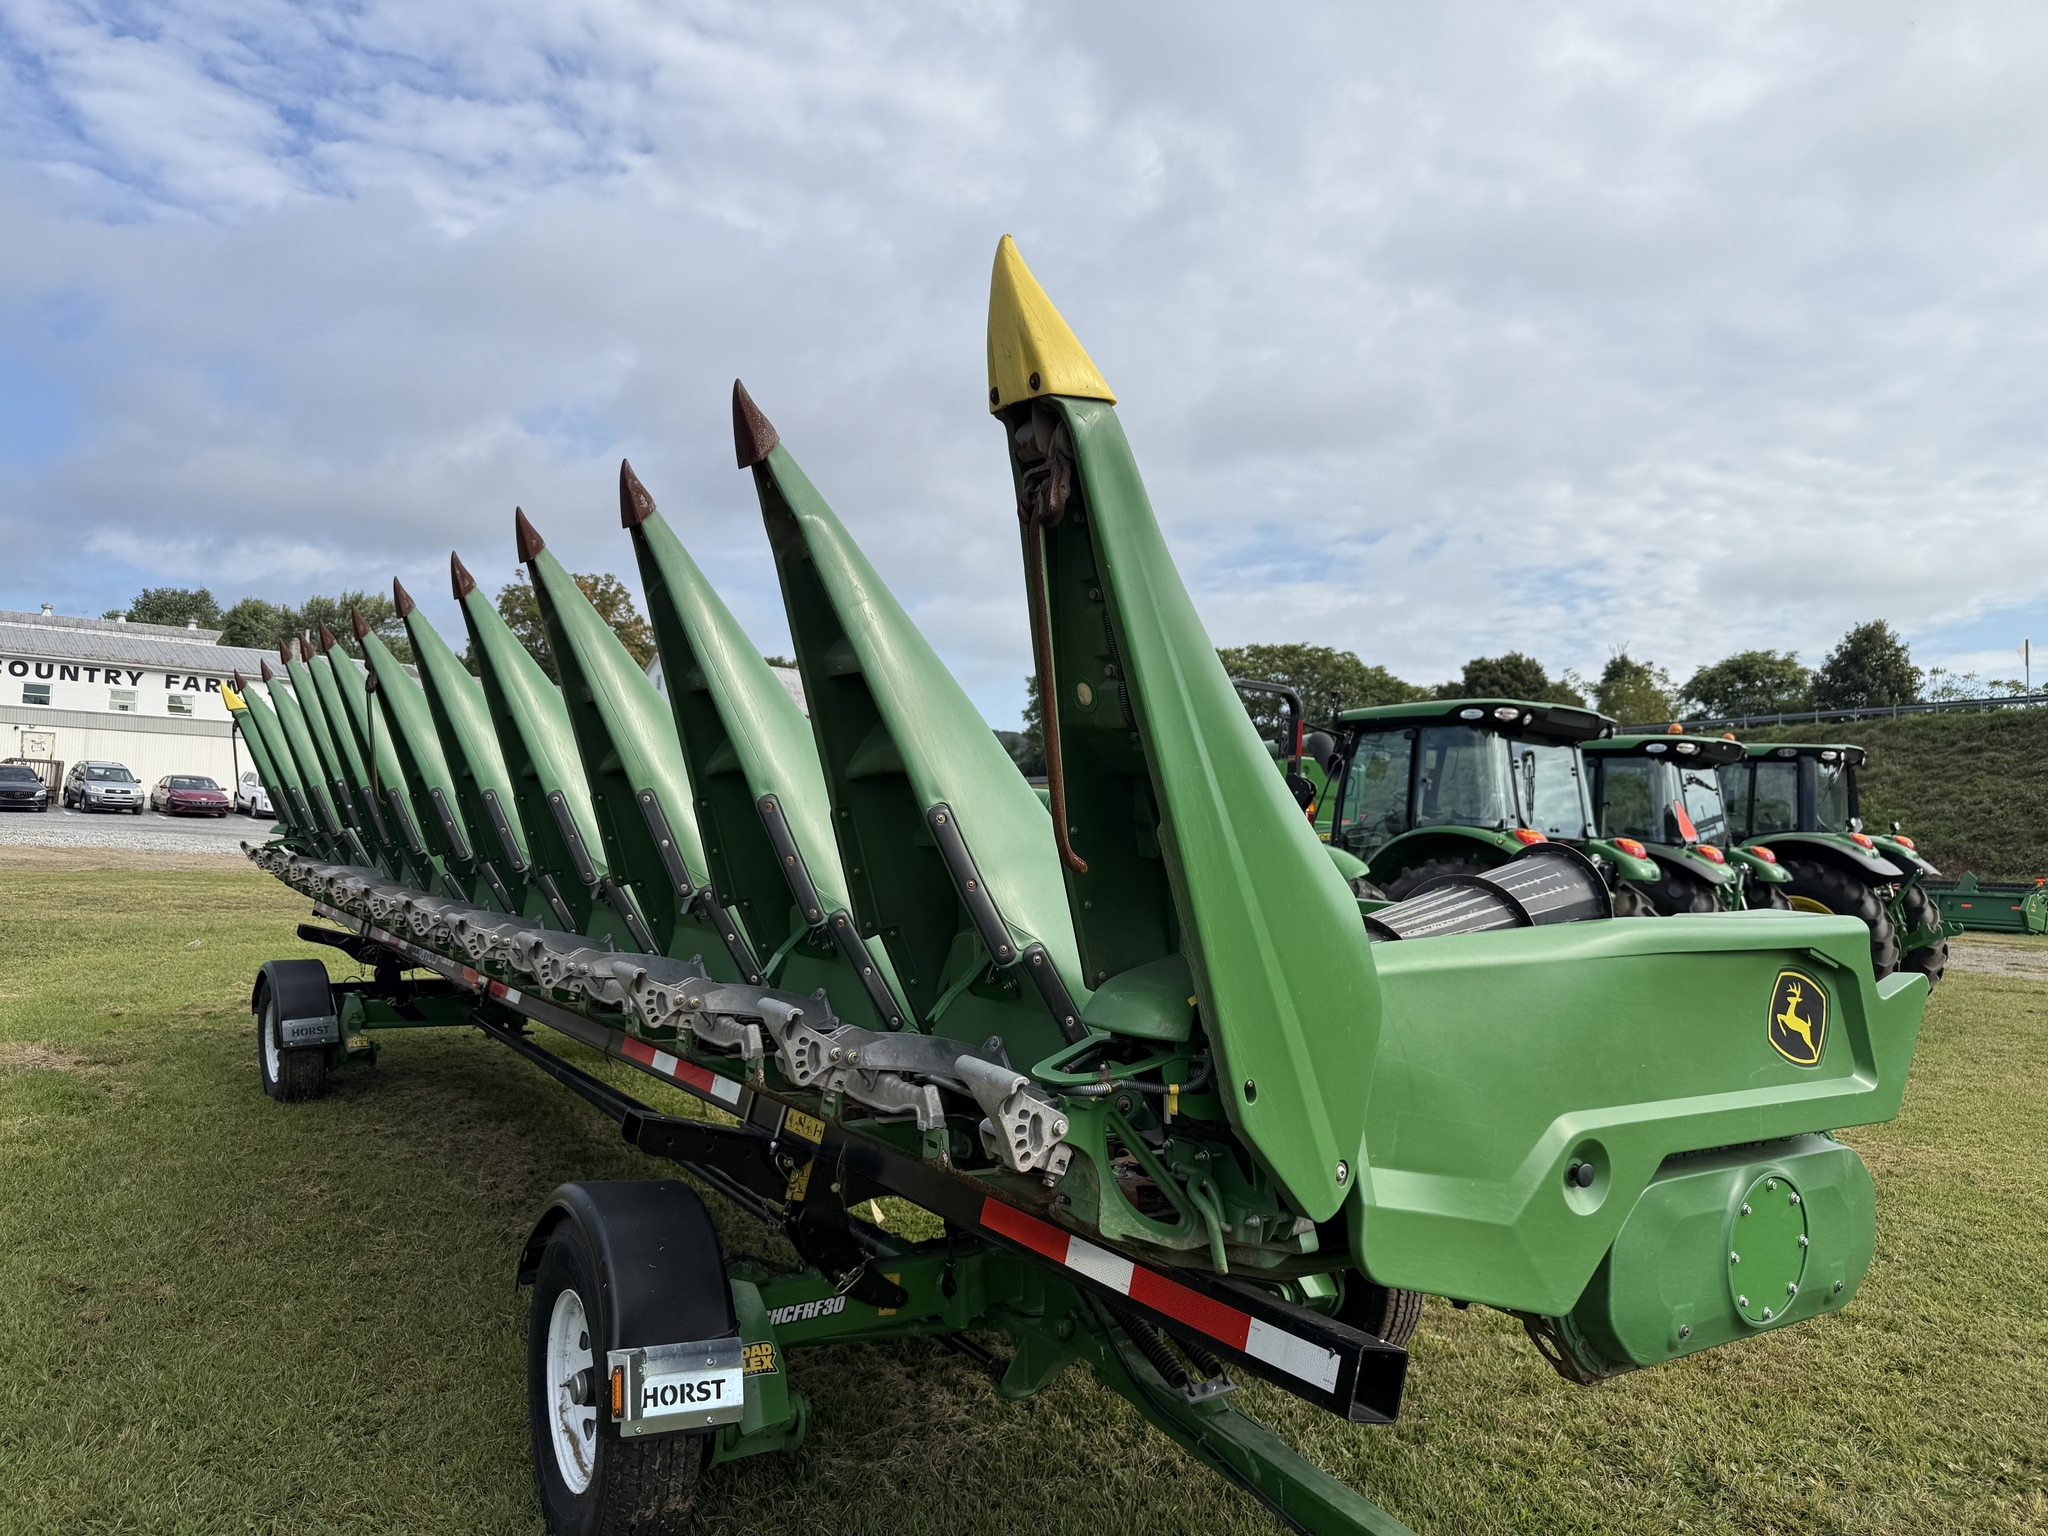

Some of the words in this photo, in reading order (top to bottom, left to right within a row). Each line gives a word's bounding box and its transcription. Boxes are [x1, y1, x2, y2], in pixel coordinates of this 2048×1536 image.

[0, 659, 144, 687] OUNTRY
[291, 1025, 330, 1038] HORST
[766, 1295, 847, 1326] HCFRF30
[742, 1343, 772, 1359] OAD
[742, 1355, 774, 1373] LEX
[643, 1378, 726, 1409] HORST
